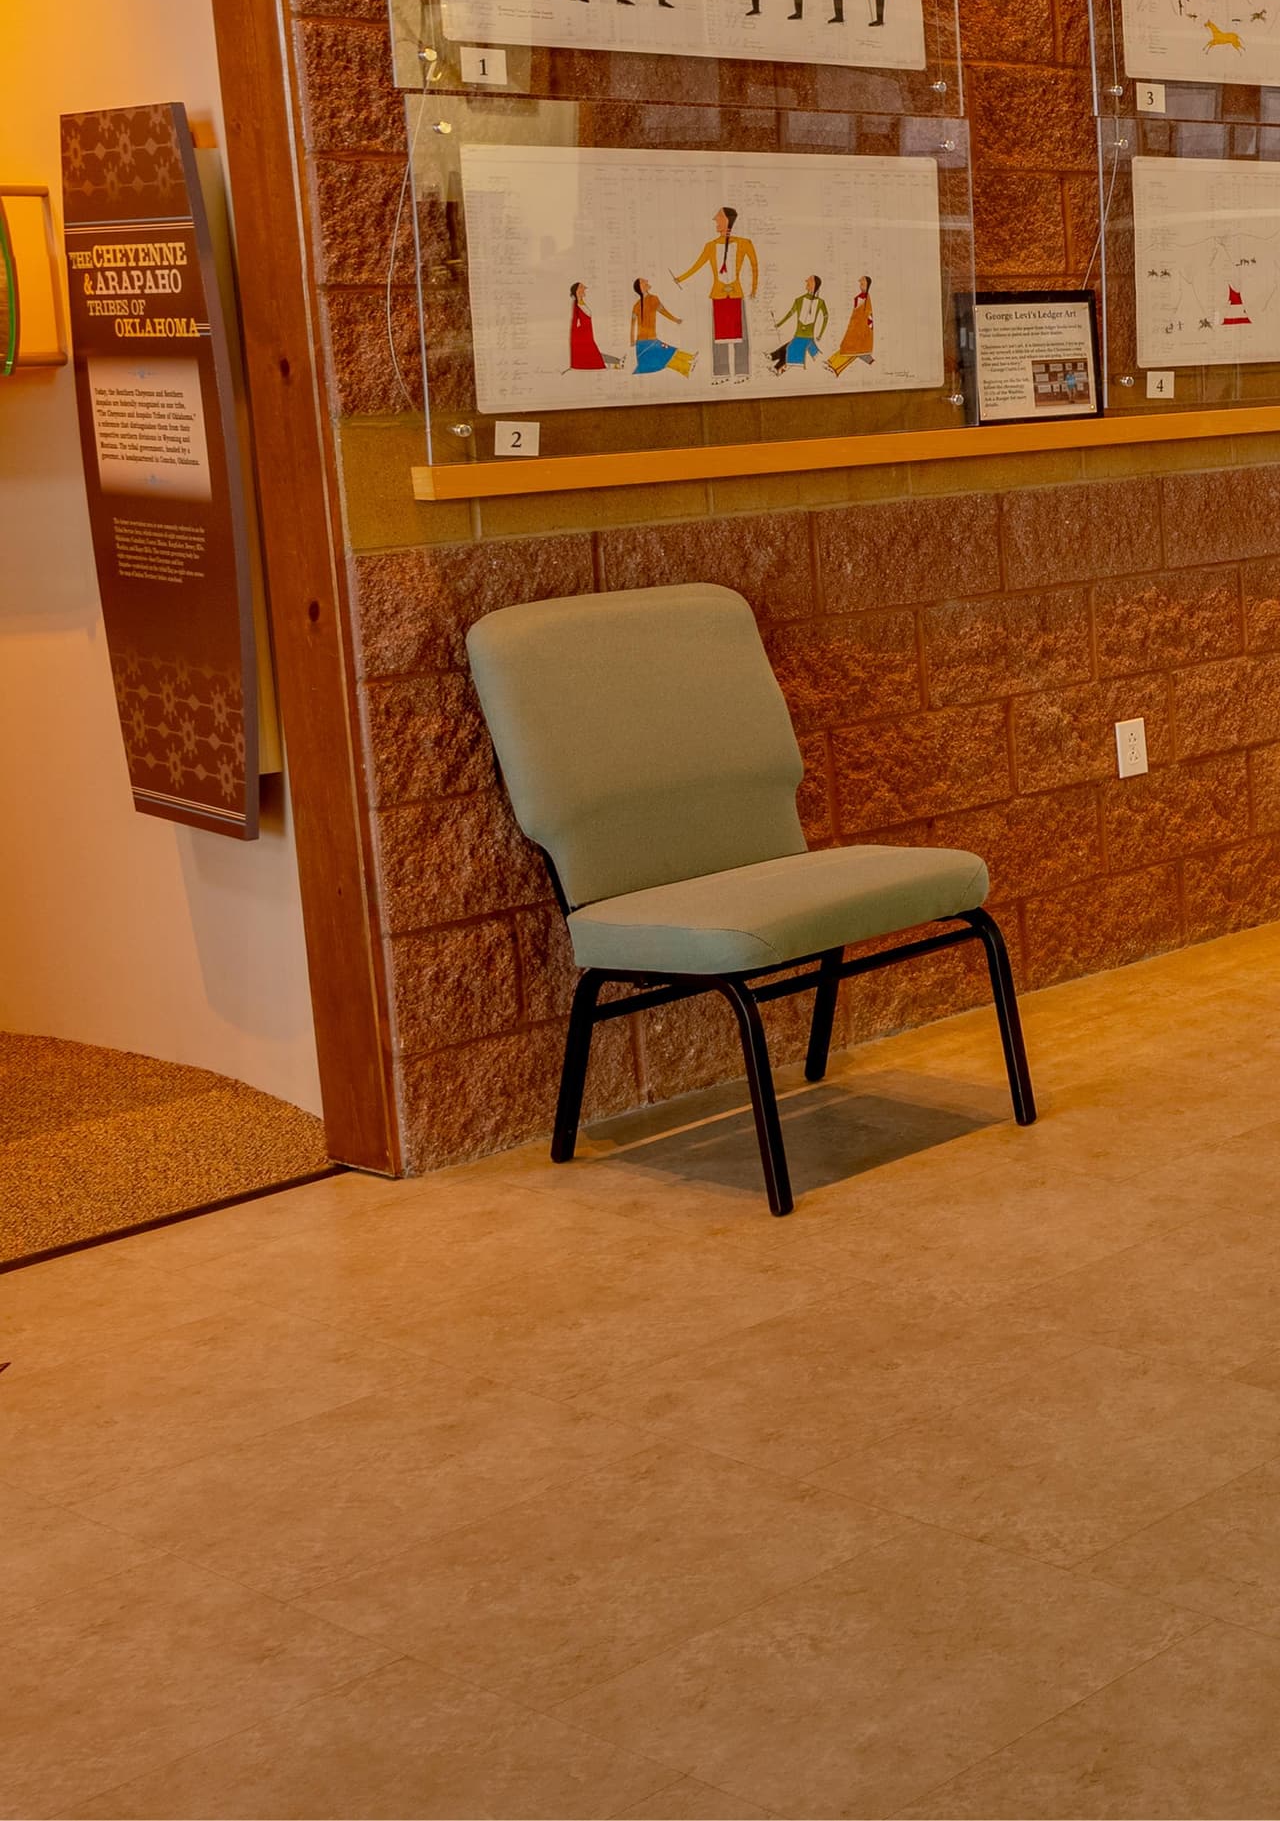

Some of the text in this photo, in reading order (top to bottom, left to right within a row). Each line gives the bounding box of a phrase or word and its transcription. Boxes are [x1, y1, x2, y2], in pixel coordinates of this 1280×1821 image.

[479, 59, 488, 76] 1
[1146, 91, 1154, 105] 3
[68, 242, 188, 269] THE CHEYENNE
[83, 269, 182, 295] & ARAPAHO
[87, 299, 146, 316] TRIBES OF
[985, 309, 1077, 321] George Levi's Ledger Art
[115, 318, 199, 338] OKLAHOMA
[1156, 379, 1164, 392] 4
[510, 431, 522, 448] 2
